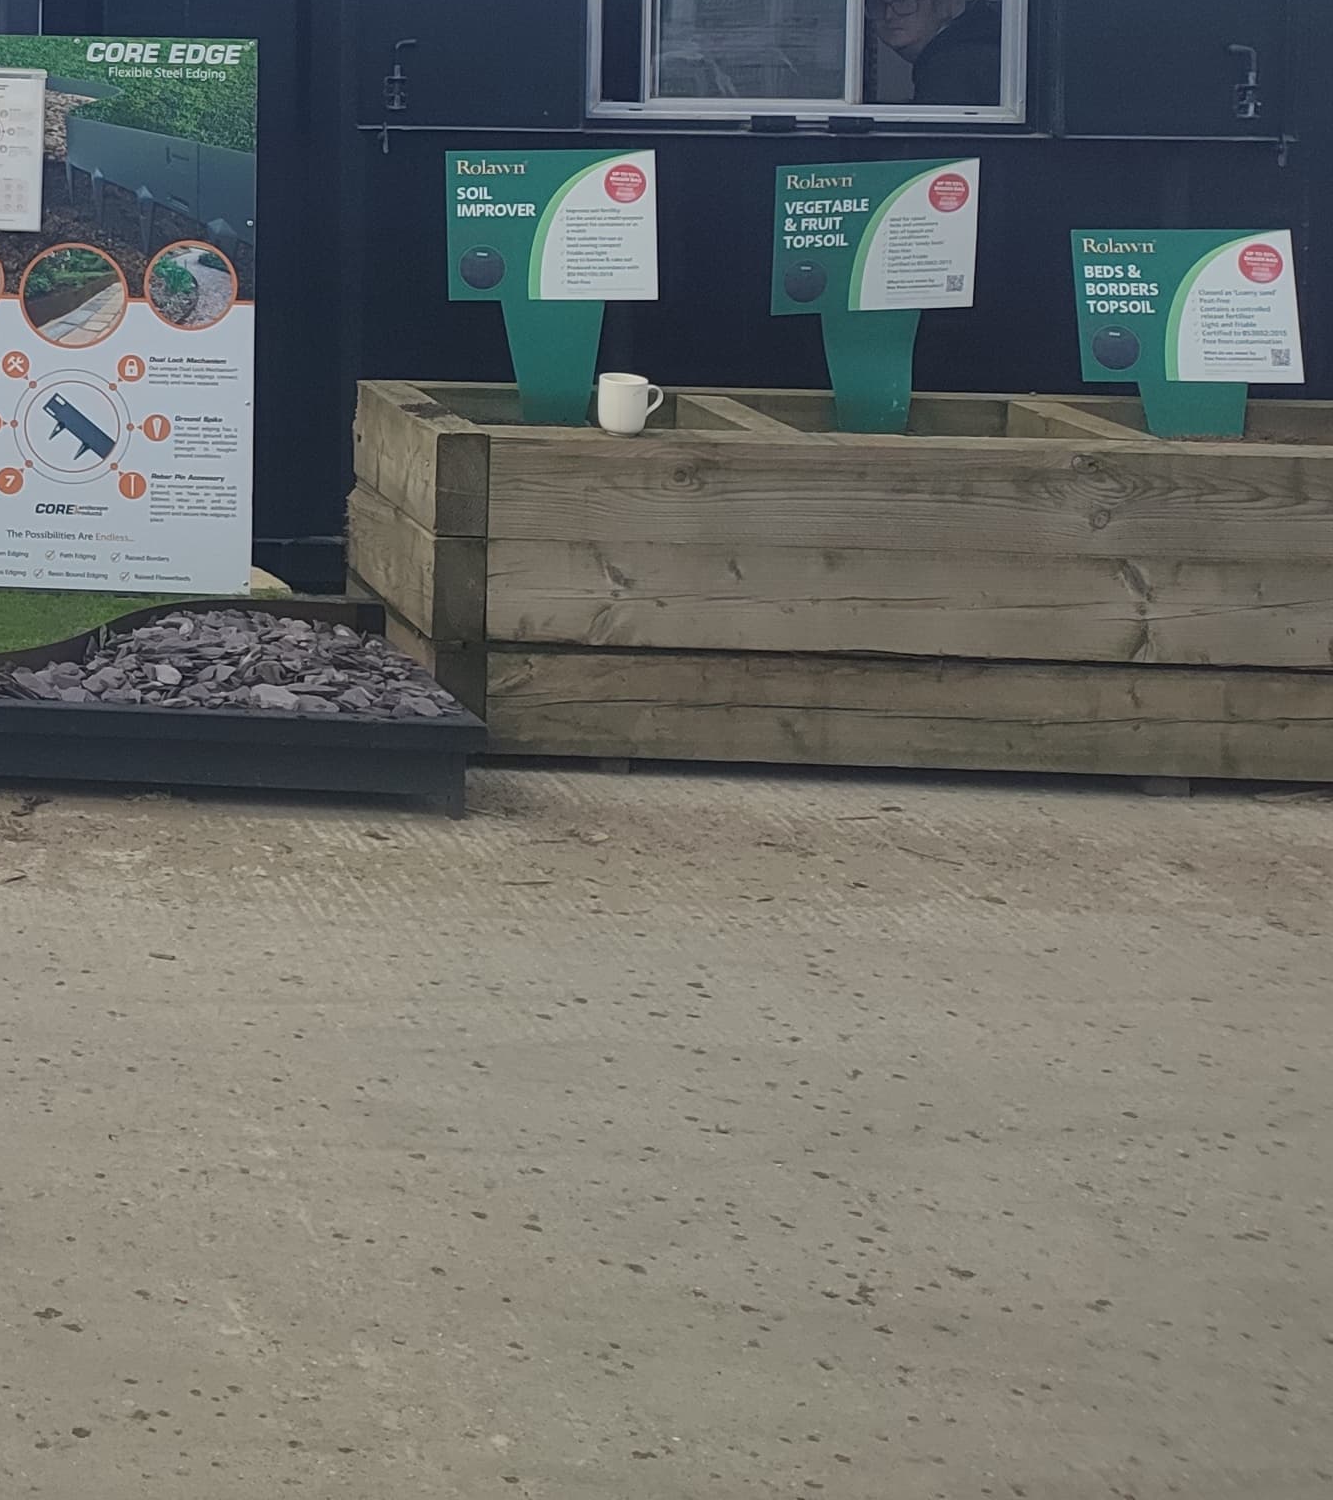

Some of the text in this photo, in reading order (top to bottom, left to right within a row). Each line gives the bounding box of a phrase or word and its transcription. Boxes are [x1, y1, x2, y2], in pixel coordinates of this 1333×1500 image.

[86, 43, 242, 65] CORE EDGE
[108, 67, 226, 81] Flexible Steel Edging
[457, 187, 493, 200] SOIL
[457, 203, 536, 217] IMPROVER
[784, 198, 869, 215] VEGETABLE
[784, 217, 843, 231] & FRUIT
[784, 234, 849, 249] TOPSOIL
[1084, 265, 1141, 279] BEDS &
[1086, 283, 1159, 296] BORDERS
[1086, 300, 1156, 314] TOPSOIL
[35, 503, 74, 514] CORE
[7, 530, 23, 538] The
[25, 530, 75, 540] Possibilities
[78, 532, 93, 540] Are
[8, 550, 29, 558] Edging
[87, 572, 108, 580] Edging
